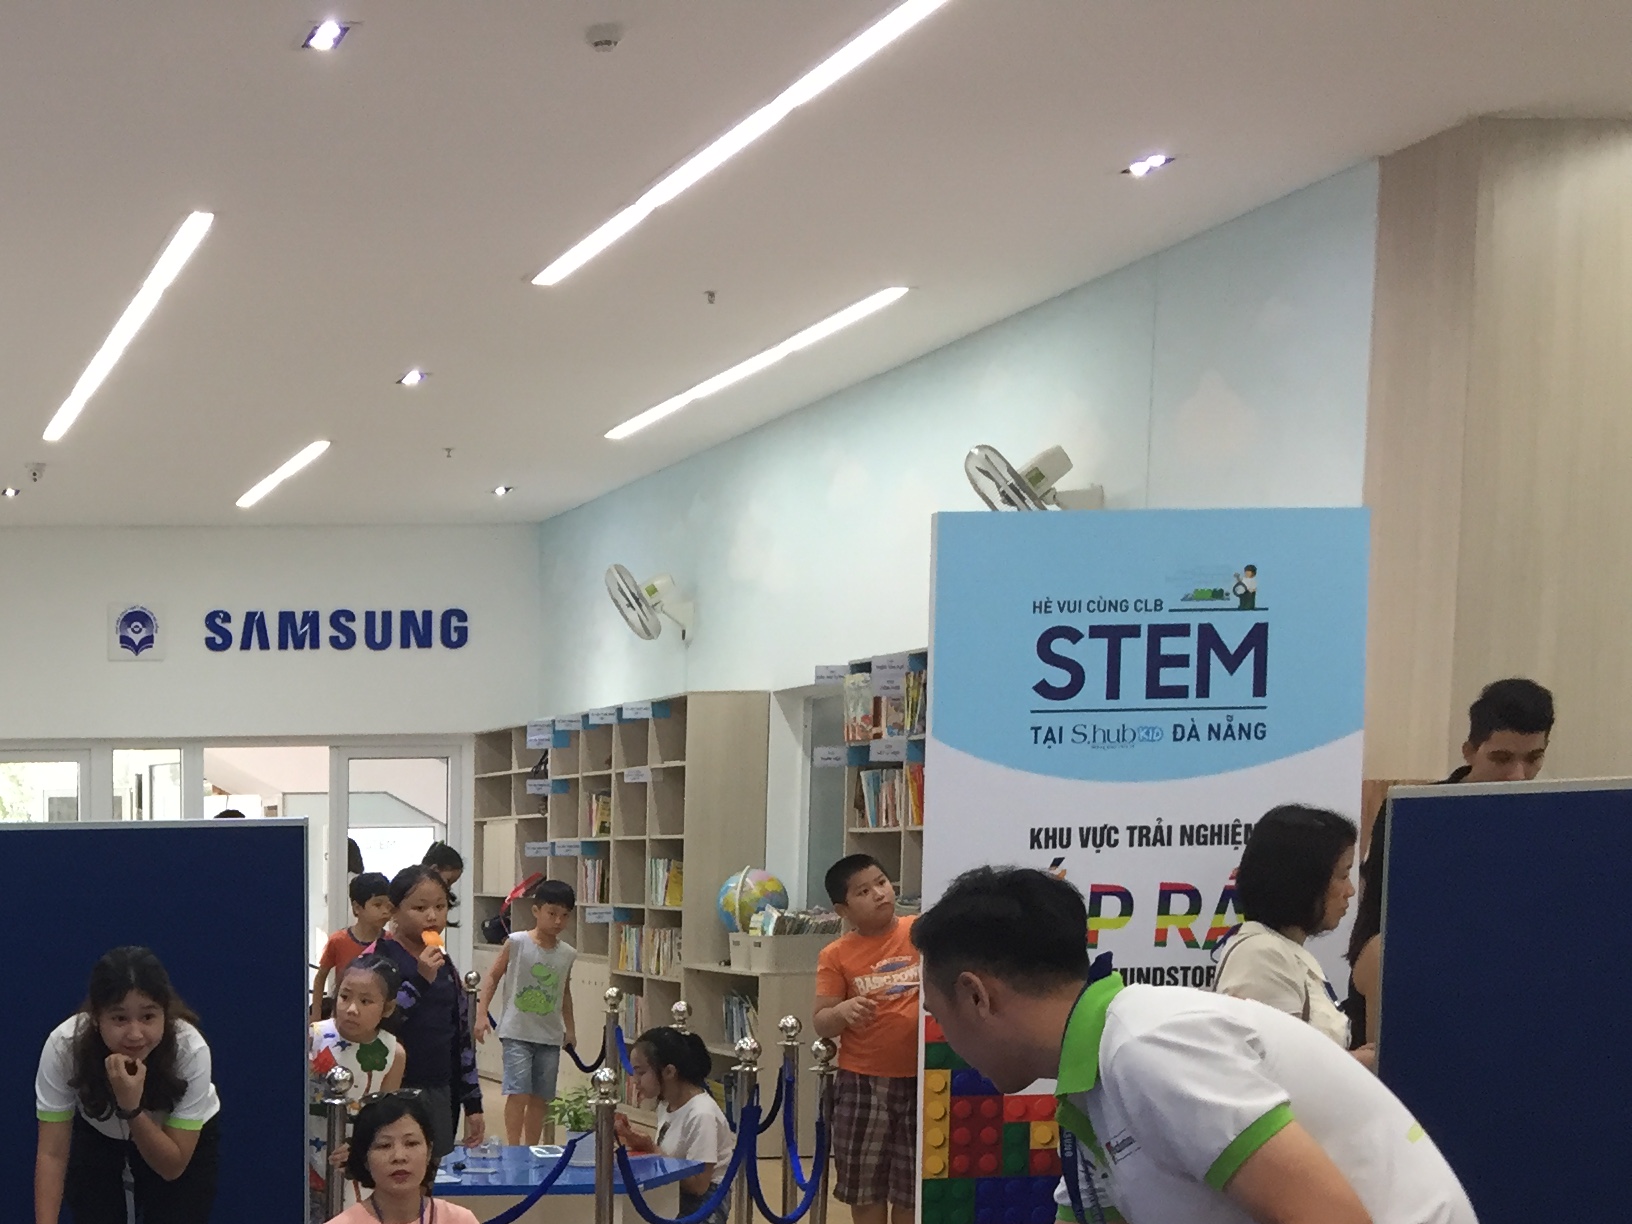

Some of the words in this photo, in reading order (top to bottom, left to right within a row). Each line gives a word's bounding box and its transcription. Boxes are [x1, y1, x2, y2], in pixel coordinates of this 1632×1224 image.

[1032, 596, 1053, 614] HÈ
[1057, 599, 1082, 613] VUI
[1086, 595, 1129, 613] CÙNG
[1133, 598, 1164, 613] CLB
[204, 608, 469, 652] SAMSUNG
[1032, 622, 1269, 701] STEM
[1030, 726, 1063, 749] TẠI
[1172, 718, 1200, 743] ĐÀ
[1029, 826, 1072, 850] KHU
[1078, 823, 1120, 854] VỰC
[1126, 817, 1173, 848] TRẢI
